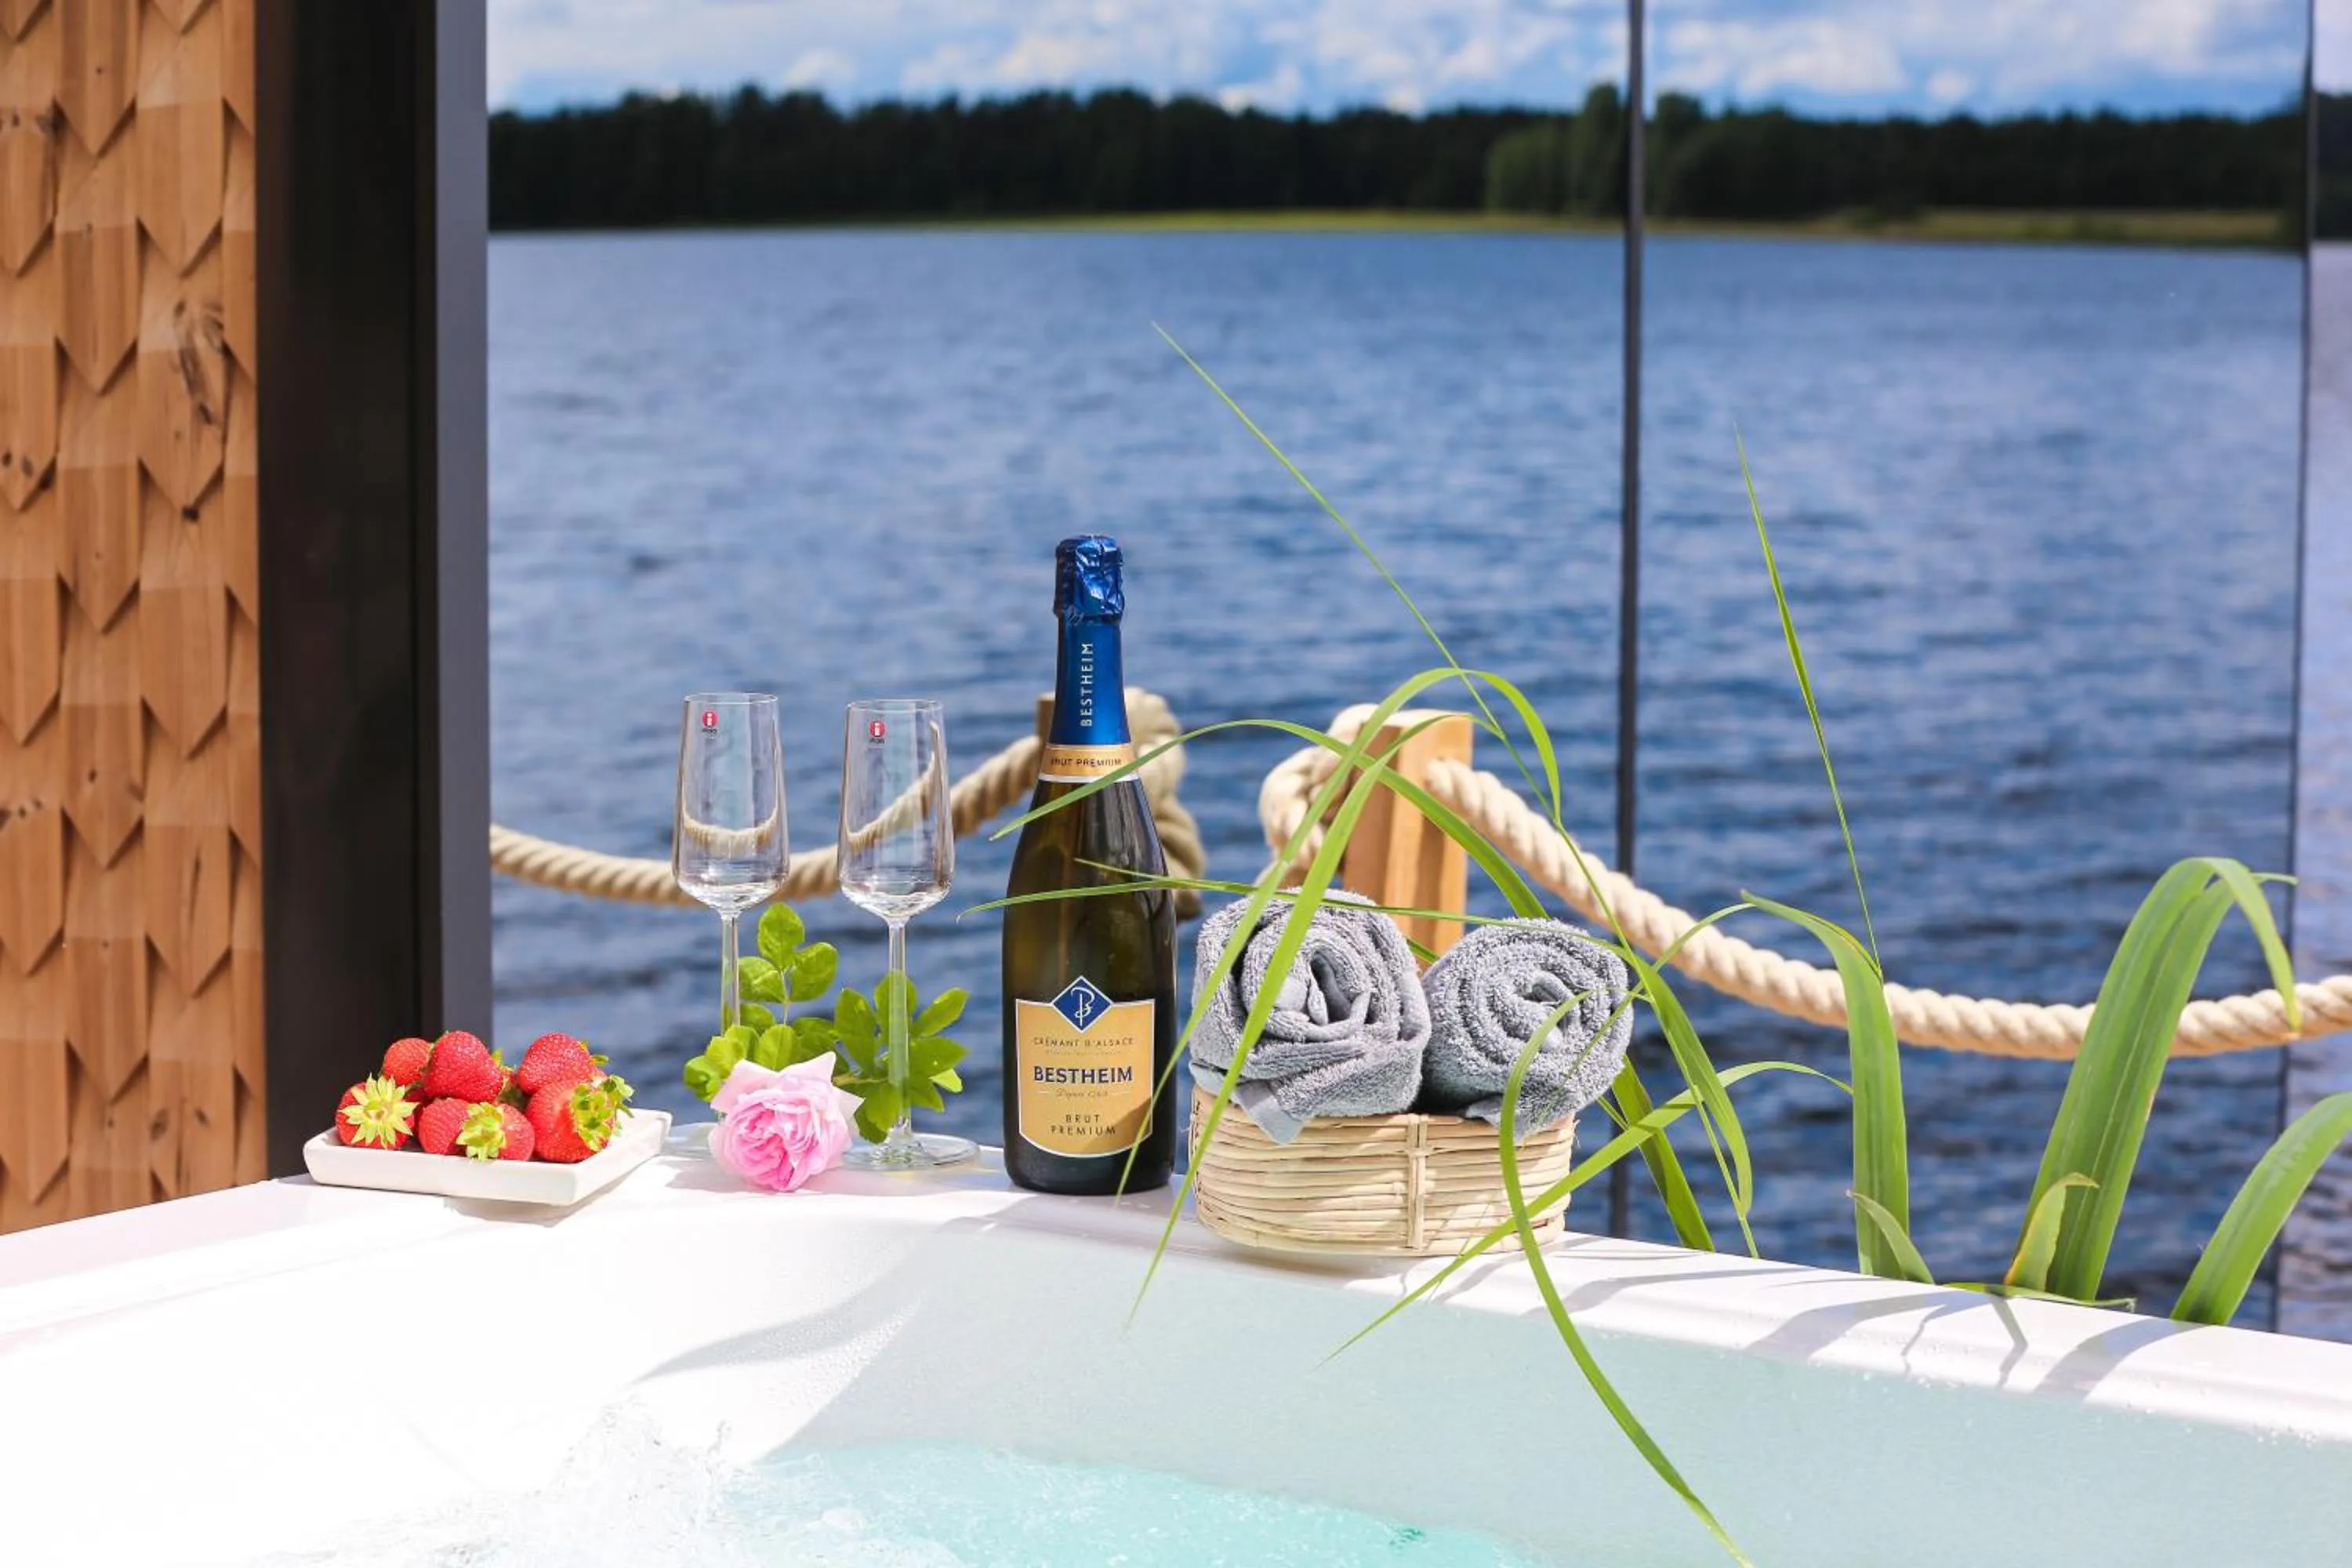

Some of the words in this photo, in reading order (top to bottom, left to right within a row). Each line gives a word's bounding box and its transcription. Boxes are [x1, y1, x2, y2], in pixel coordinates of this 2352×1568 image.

[1080, 642, 1094, 728] BESTHEIM
[1077, 758, 1122, 767] PREMIUM
[1033, 1065, 1132, 1084] BESTHEIM
[1065, 1114, 1099, 1123] BRUT
[1051, 1125, 1116, 1136] PREMIUM
